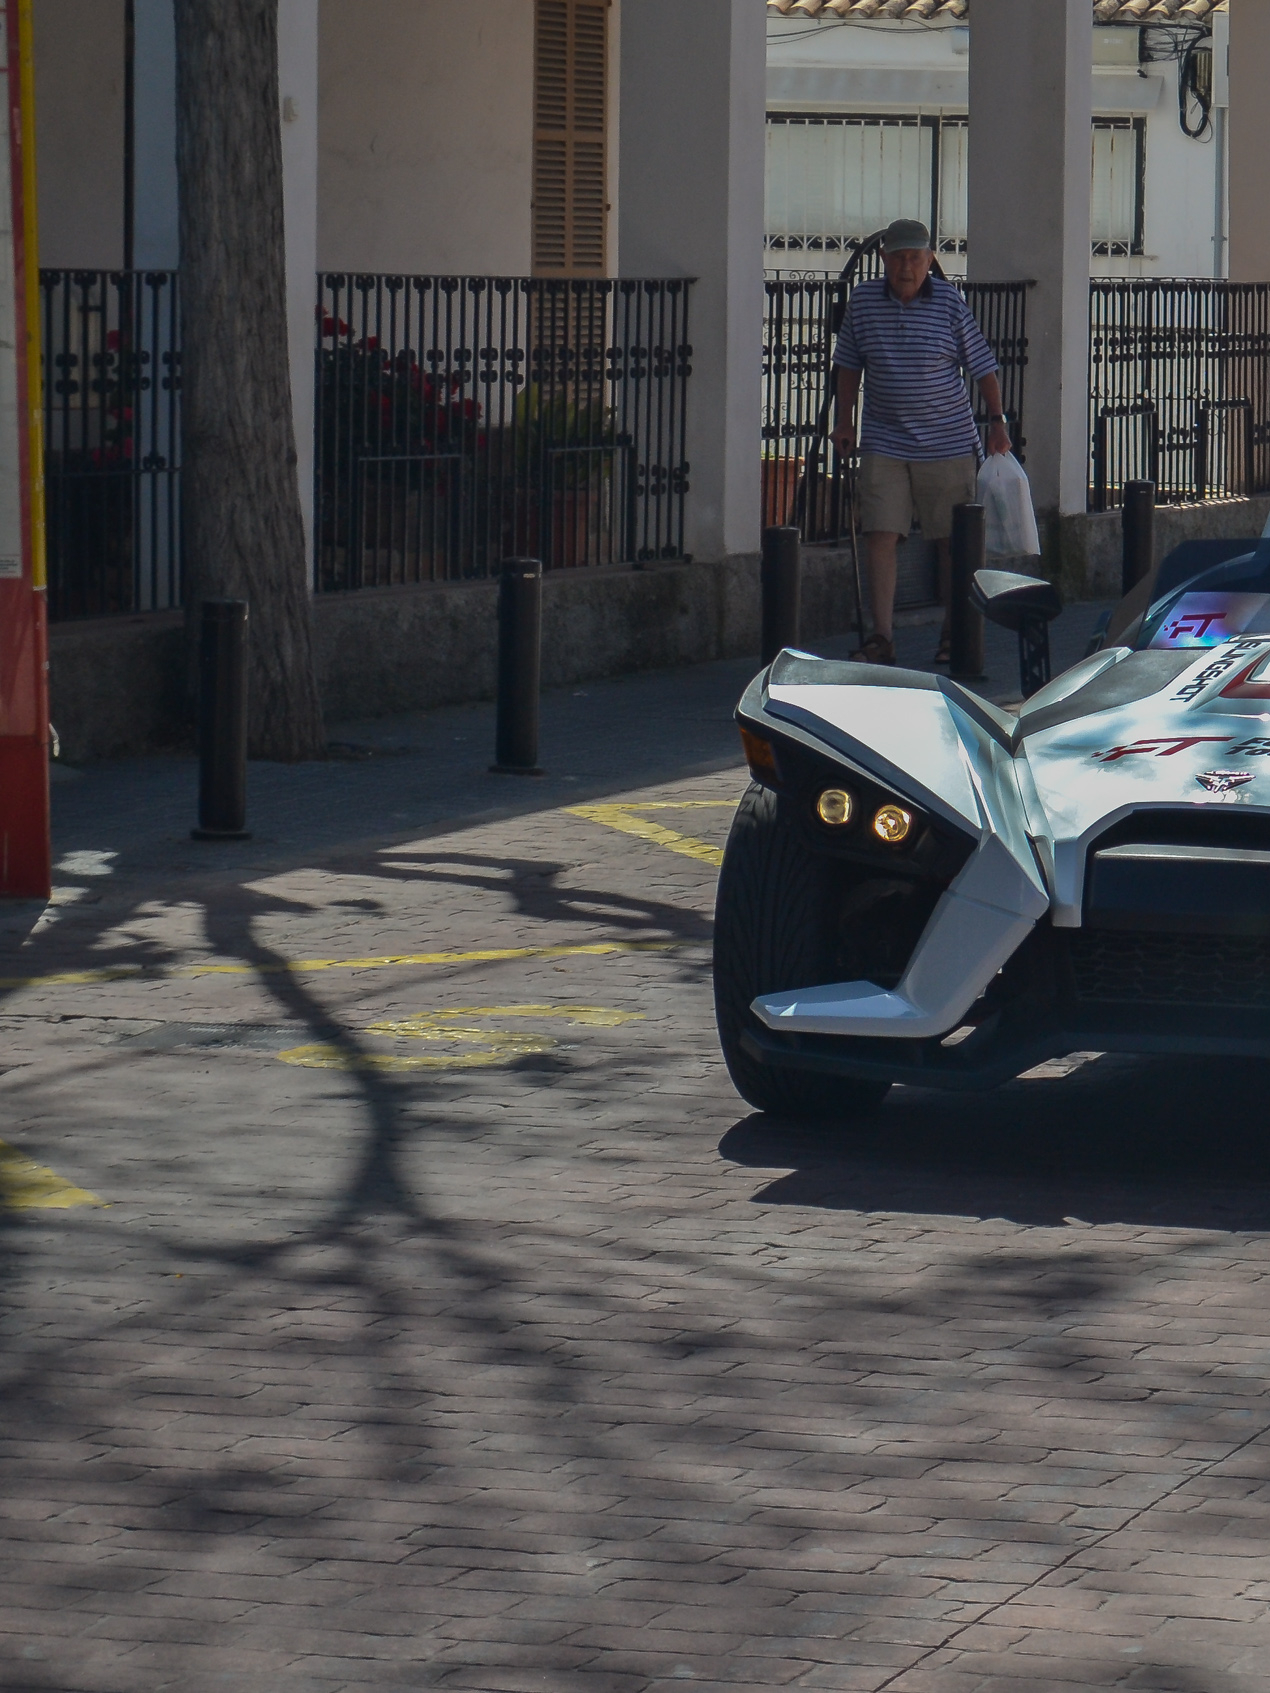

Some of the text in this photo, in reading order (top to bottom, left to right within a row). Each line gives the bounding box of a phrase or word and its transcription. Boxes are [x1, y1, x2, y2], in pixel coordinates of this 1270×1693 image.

[1166, 612, 1228, 639] FT
[1169, 641, 1261, 702] SLINGSHOT
[1091, 736, 1236, 762] FT
